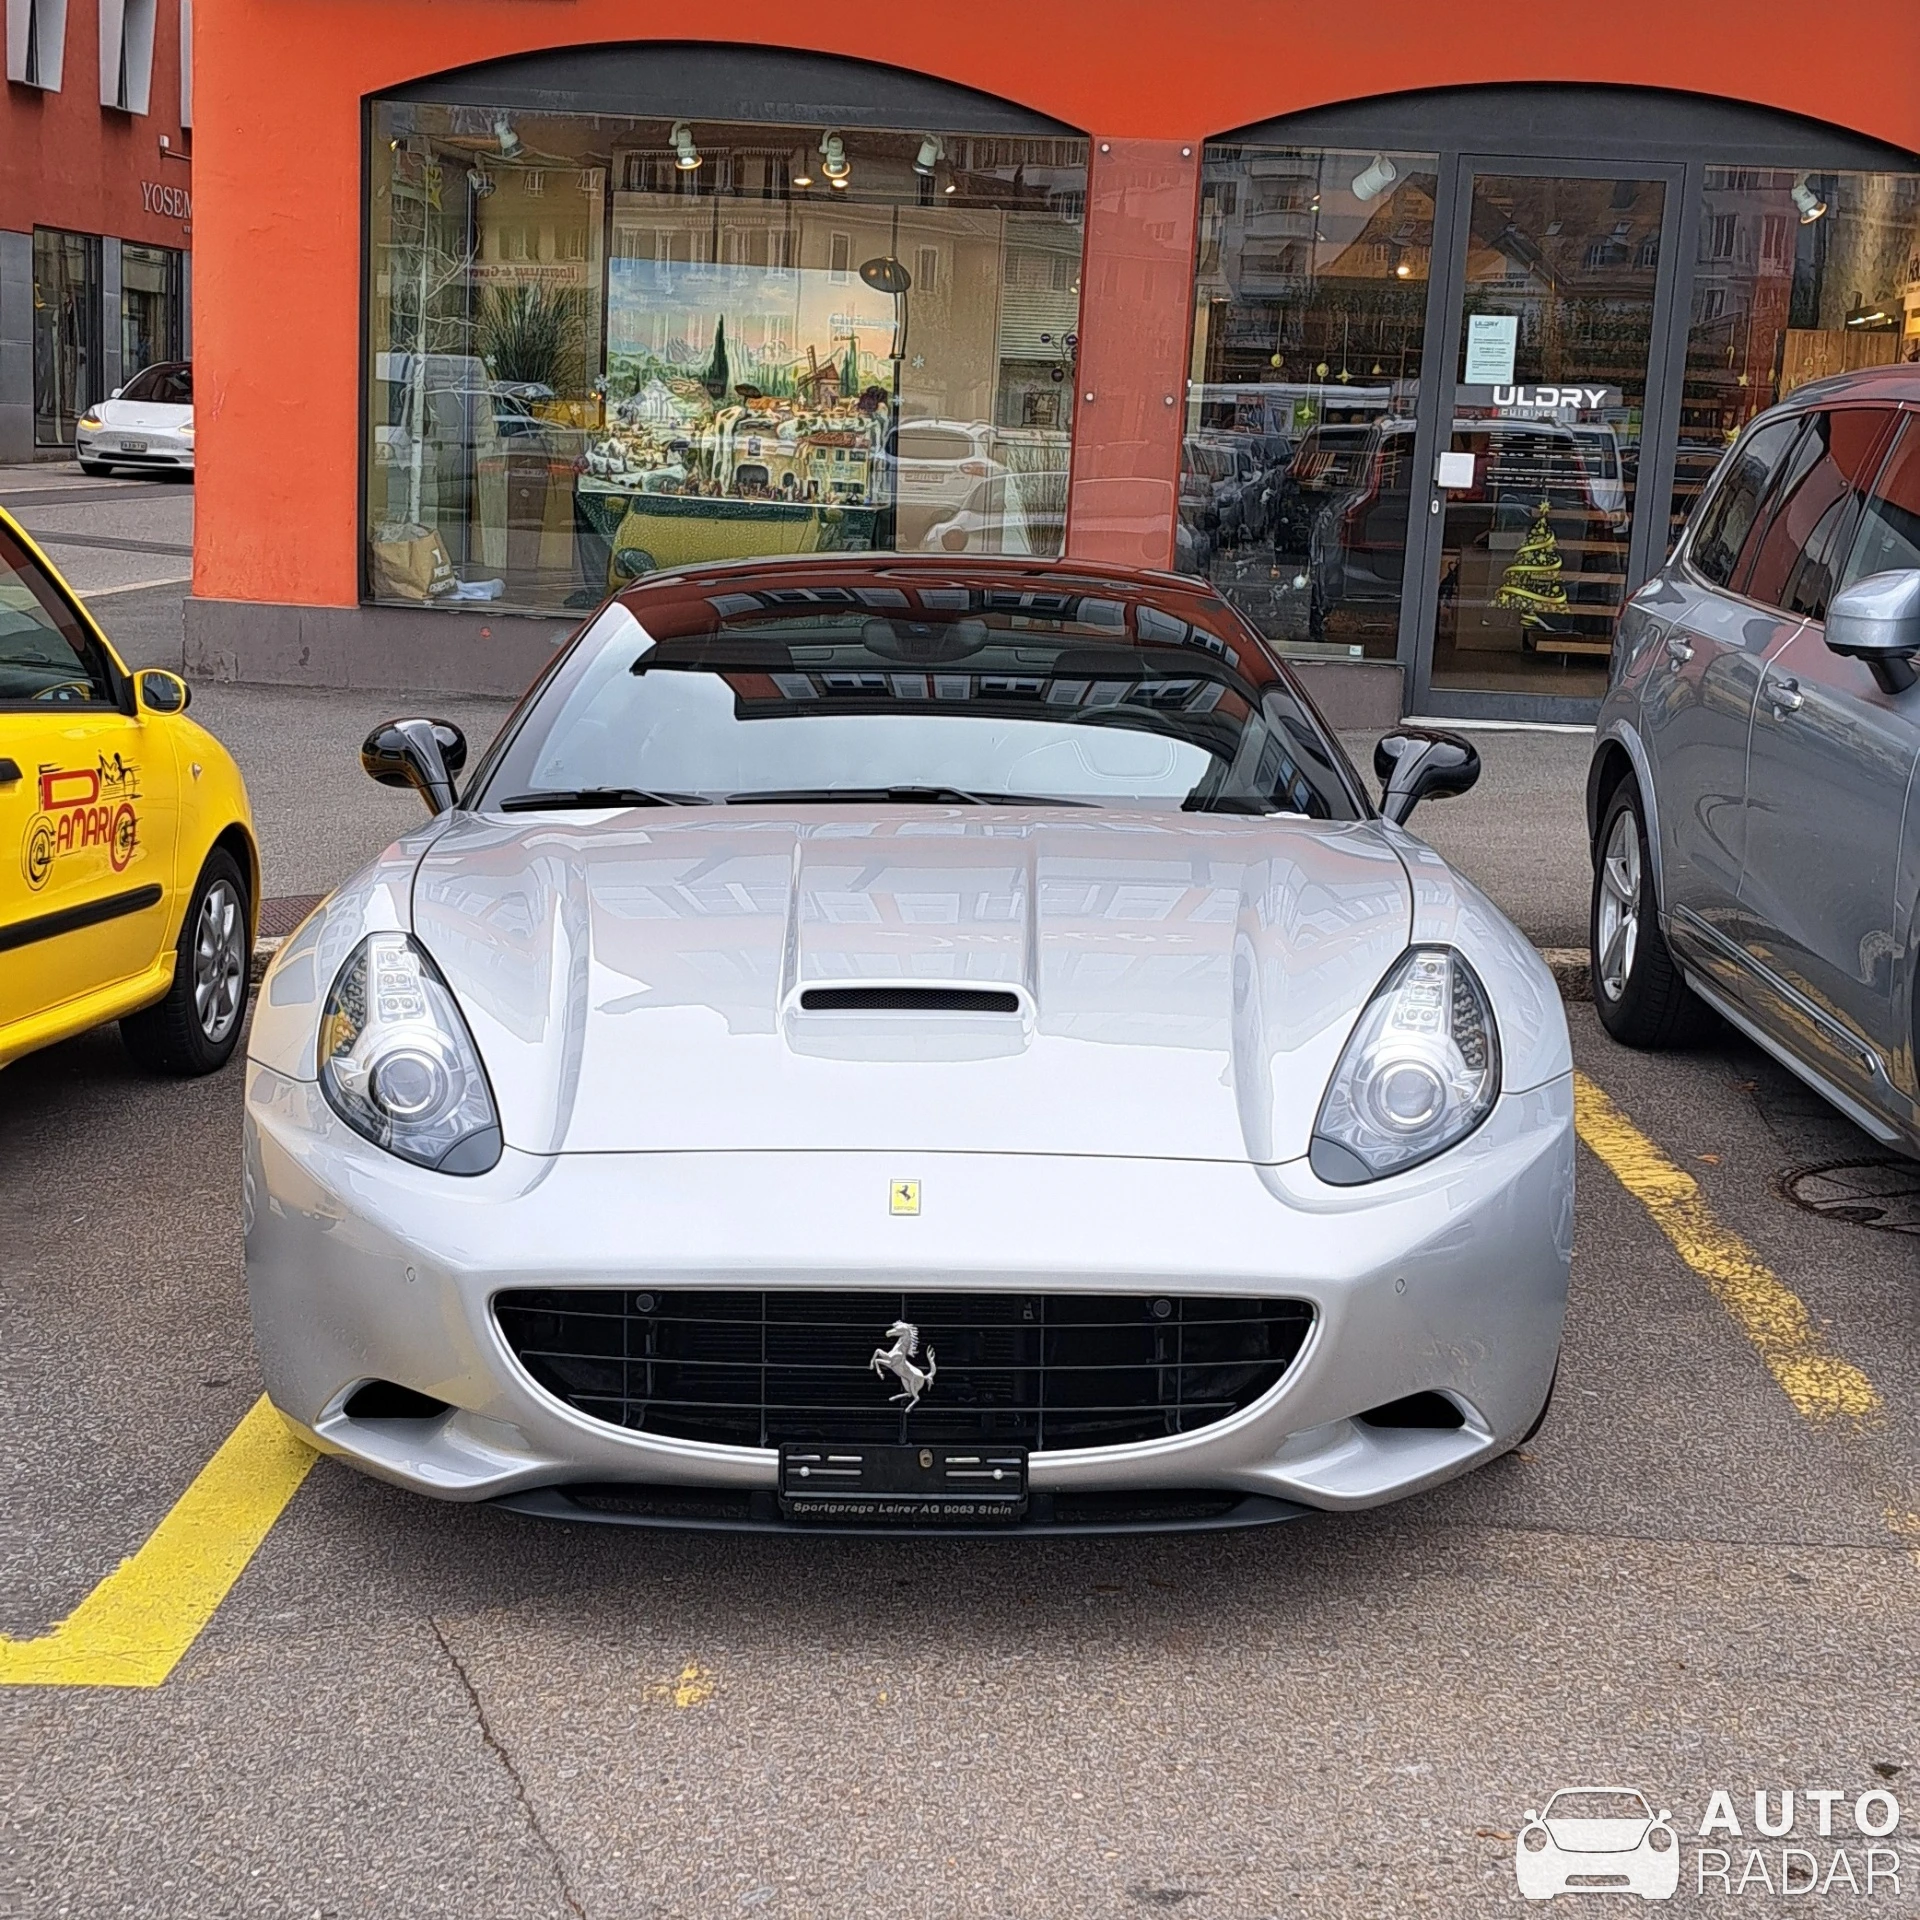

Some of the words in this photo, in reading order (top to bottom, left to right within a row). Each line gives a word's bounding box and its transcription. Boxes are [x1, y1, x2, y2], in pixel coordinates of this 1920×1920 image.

[1493, 385, 1608, 409] ULDRY
[793, 1502, 875, 1514] Sportgarage
[920, 1504, 940, 1515] AG
[943, 1505, 975, 1515] 9063
[978, 1504, 1012, 1516] Stein
